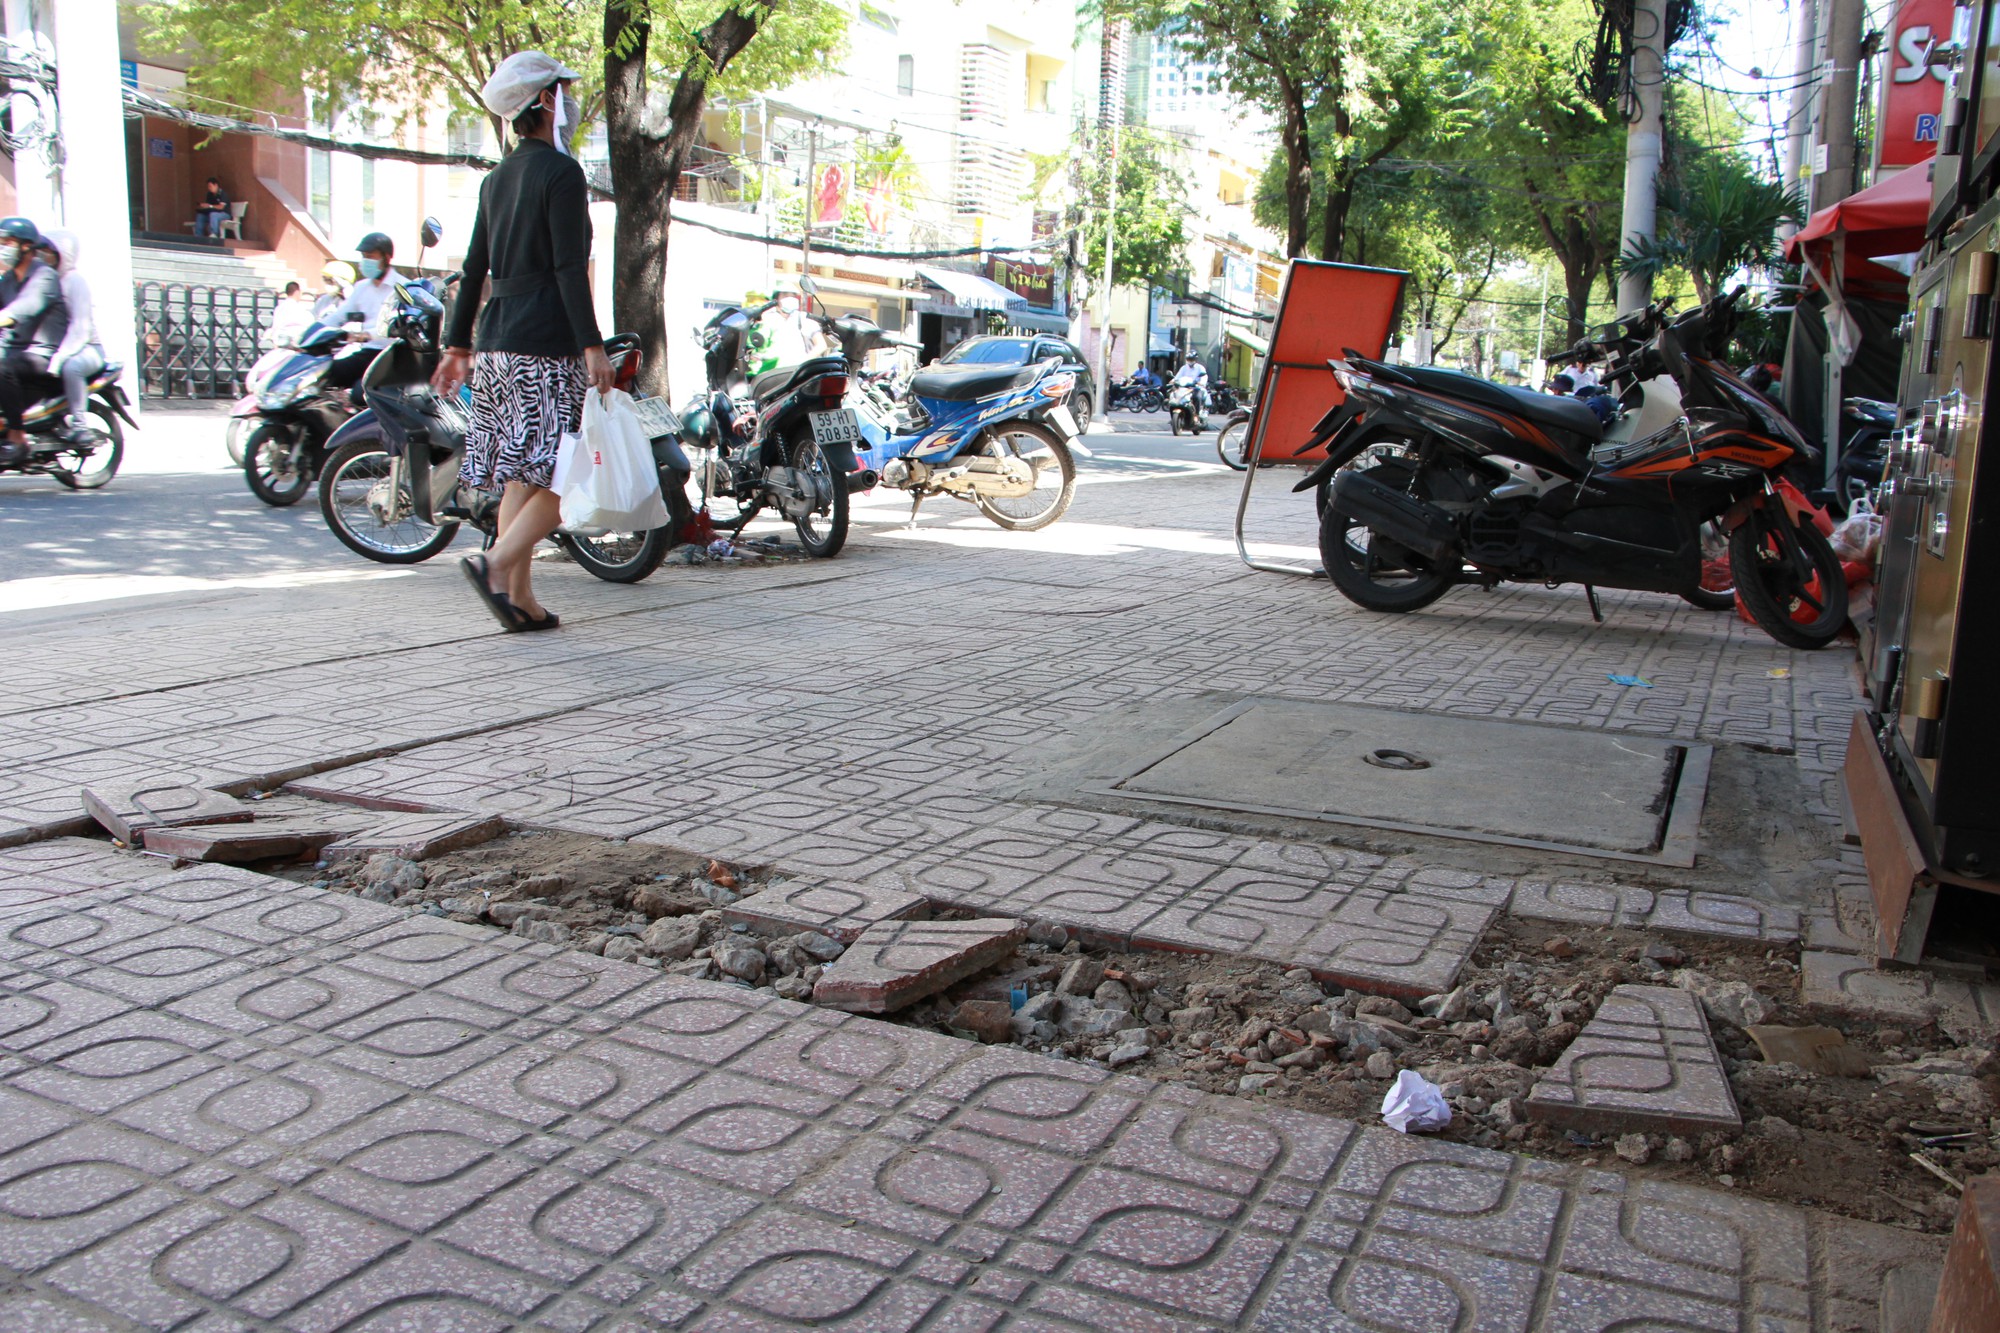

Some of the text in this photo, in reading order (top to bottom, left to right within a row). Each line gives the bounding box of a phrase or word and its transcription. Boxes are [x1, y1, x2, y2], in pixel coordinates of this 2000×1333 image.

[818, 411, 850, 427] 59-H1
[817, 425, 859, 442] 508.93
[1731, 451, 1766, 463] HONDA
